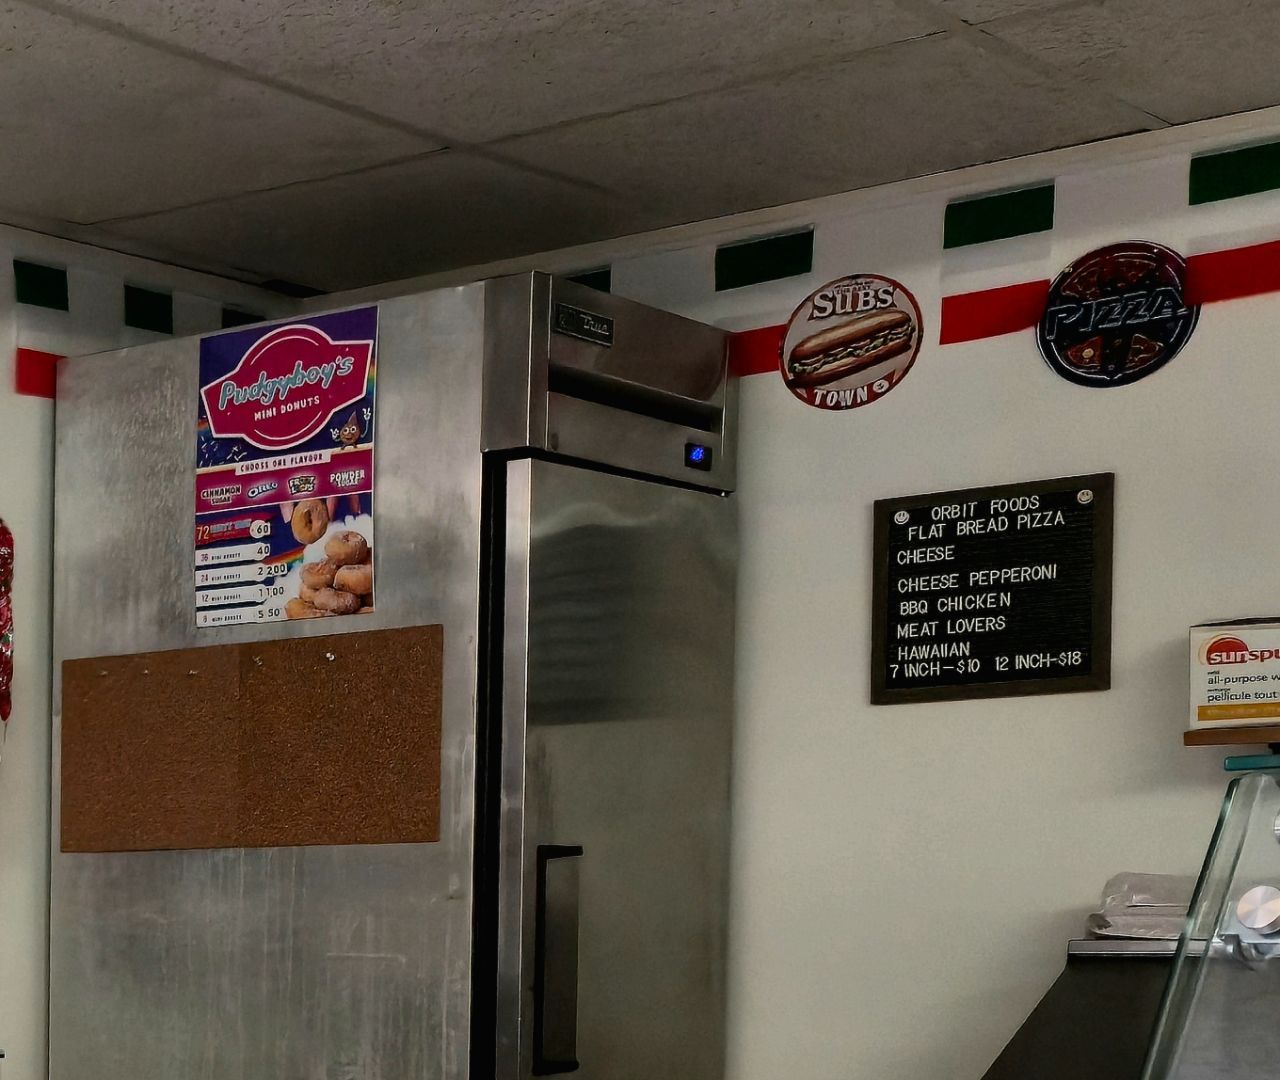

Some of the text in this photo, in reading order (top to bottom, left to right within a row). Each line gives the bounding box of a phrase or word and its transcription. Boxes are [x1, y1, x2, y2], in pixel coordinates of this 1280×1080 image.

[813, 285, 894, 318] SUBS
[1045, 287, 1188, 340] PIZZA
[218, 355, 354, 410] Pudgyboy's
[814, 385, 868, 407] TOWN
[254, 396, 320, 422] MINI DONUTS
[272, 459, 286, 467] ONE
[291, 453, 323, 465] FLAVOUR
[330, 470, 365, 483] POWDER
[201, 485, 241, 498] CINNAMON
[248, 482, 278, 498] OREO
[931, 495, 1040, 521] ORBIT FOODS
[197, 526, 210, 540] 72
[257, 525, 268, 533] 60
[908, 510, 1065, 541] FLAT BREAD PIZZA
[257, 546, 270, 554] 40
[897, 546, 955, 565] CHEESE
[897, 564, 1057, 594] CHEESE PEPPERONI
[900, 592, 1011, 616] BBQ CHICKEN
[897, 616, 1006, 639] MEAT LOVERS
[898, 641, 970, 661] HAWAIIAN
[889, 664, 899, 679] 7
[995, 656, 1009, 671] 12
[1208, 674, 1268, 685] all-purpose
[1208, 692, 1251, 703] pellicule
